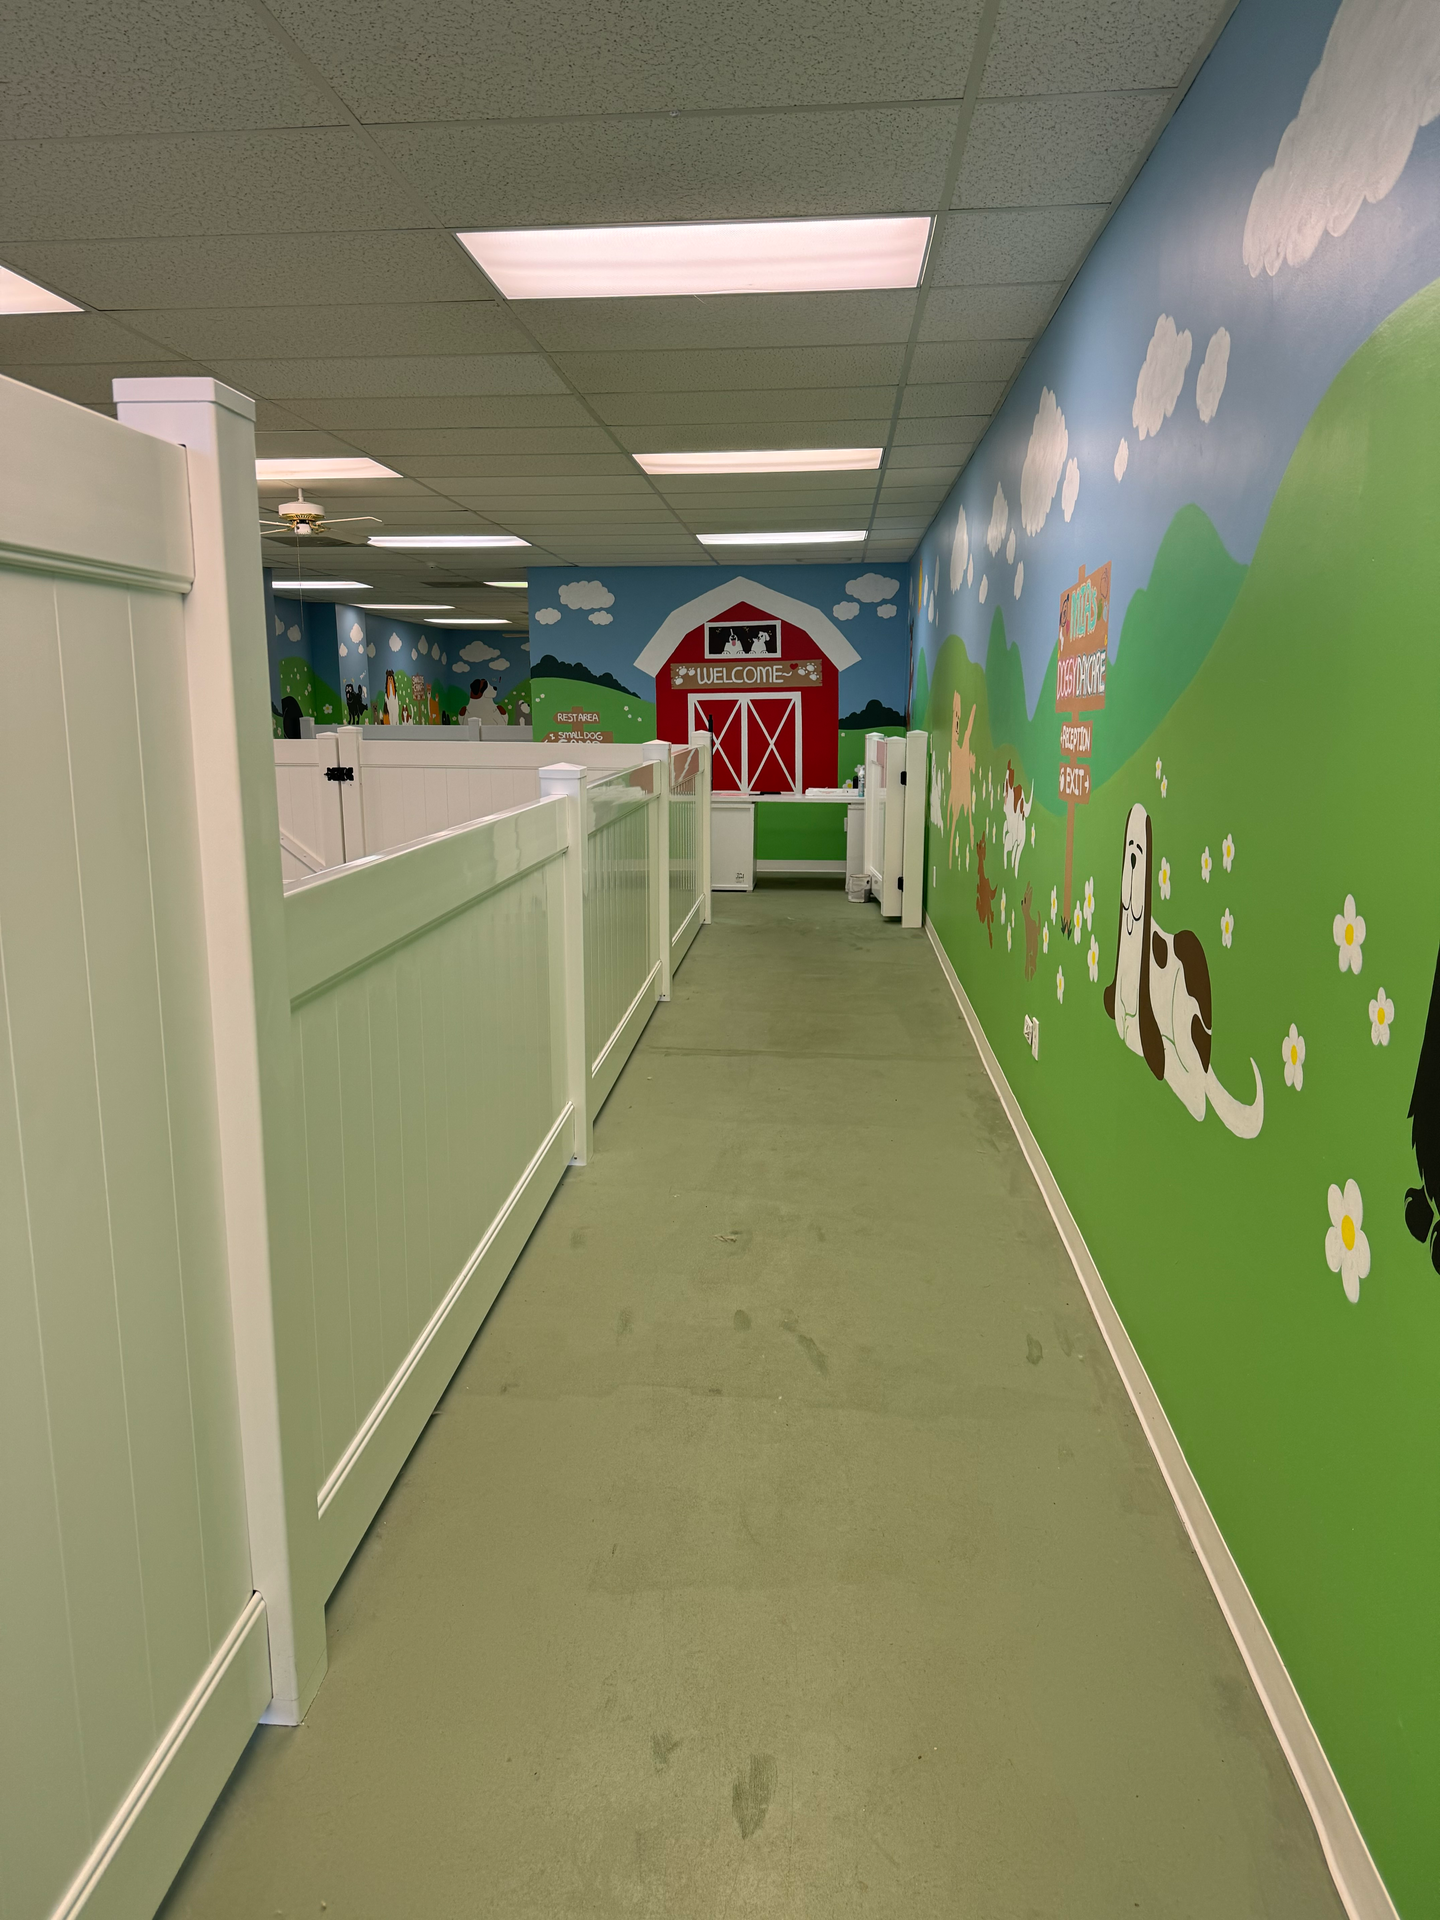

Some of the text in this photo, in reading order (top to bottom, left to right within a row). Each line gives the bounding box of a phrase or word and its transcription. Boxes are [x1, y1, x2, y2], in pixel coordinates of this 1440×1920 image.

[697, 665, 784, 685] WELCOME
[1057, 649, 1106, 700] DOGGY DAYCARE
[557, 713, 599, 722] REST AREA
[558, 731, 583, 739] SMALL
[584, 731, 603, 741] DOG
[1062, 725, 1091, 752] RECEPTION
[1066, 766, 1085, 796] EXIT
